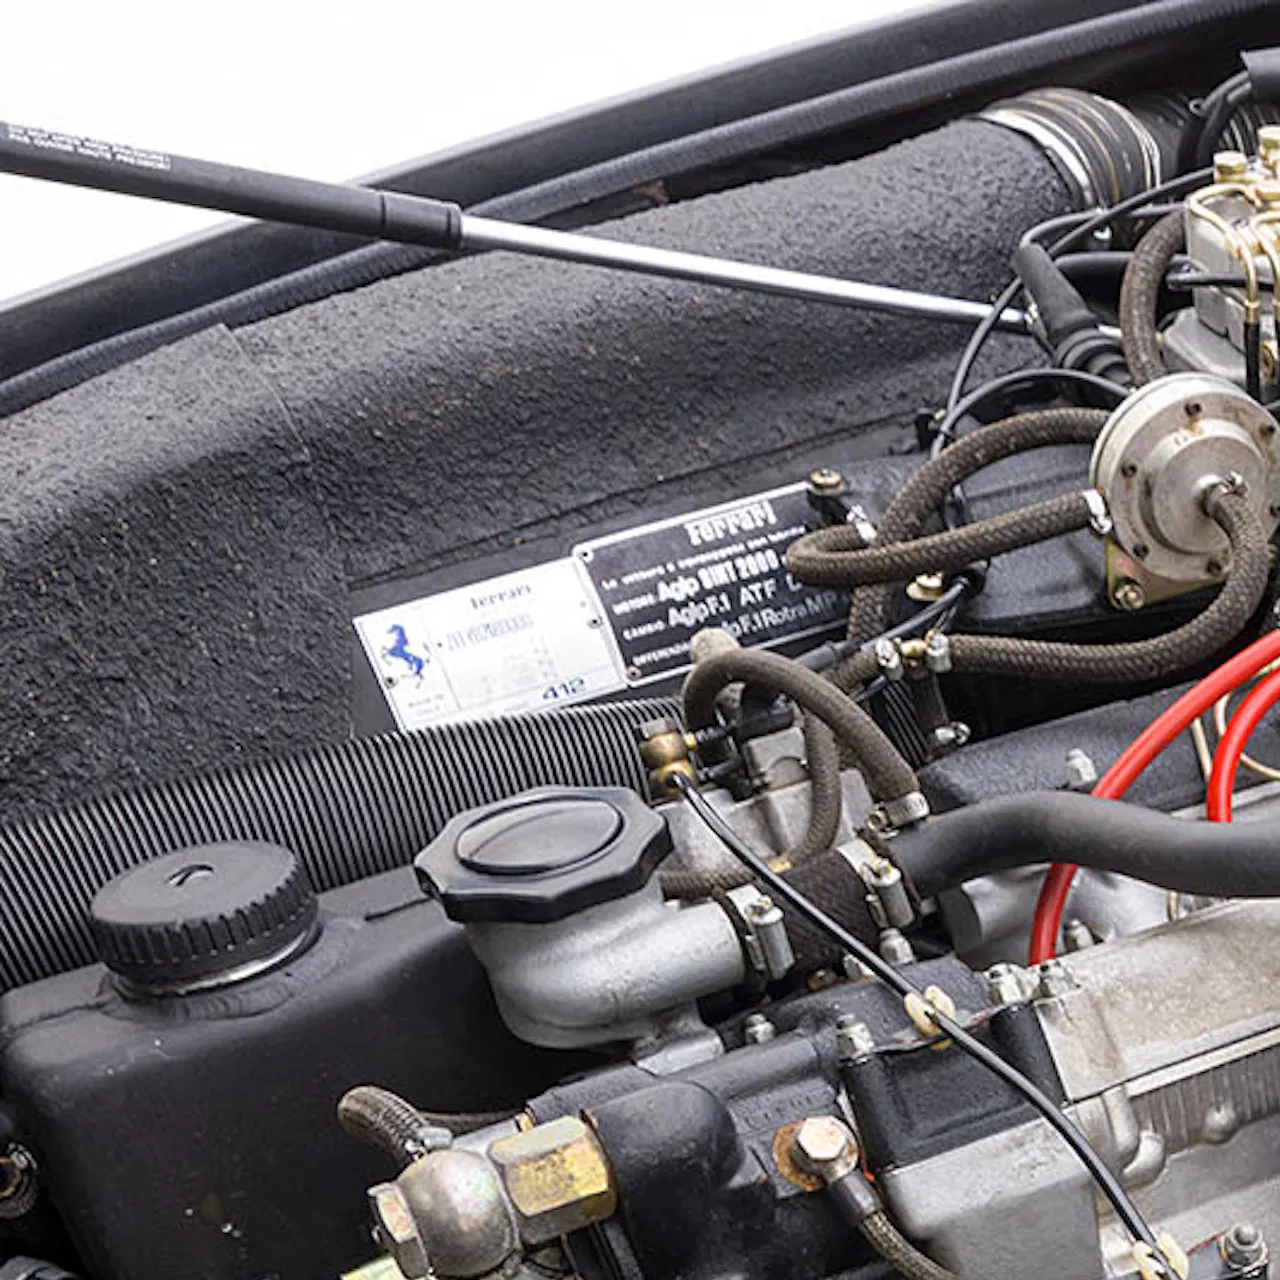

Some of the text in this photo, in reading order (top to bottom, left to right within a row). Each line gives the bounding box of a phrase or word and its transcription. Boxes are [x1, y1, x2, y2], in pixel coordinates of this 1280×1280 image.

[684, 500, 777, 546] Ferrari
[736, 548, 780, 581] 2000
[739, 577, 778, 607] ATF
[541, 677, 588, 701] 412
